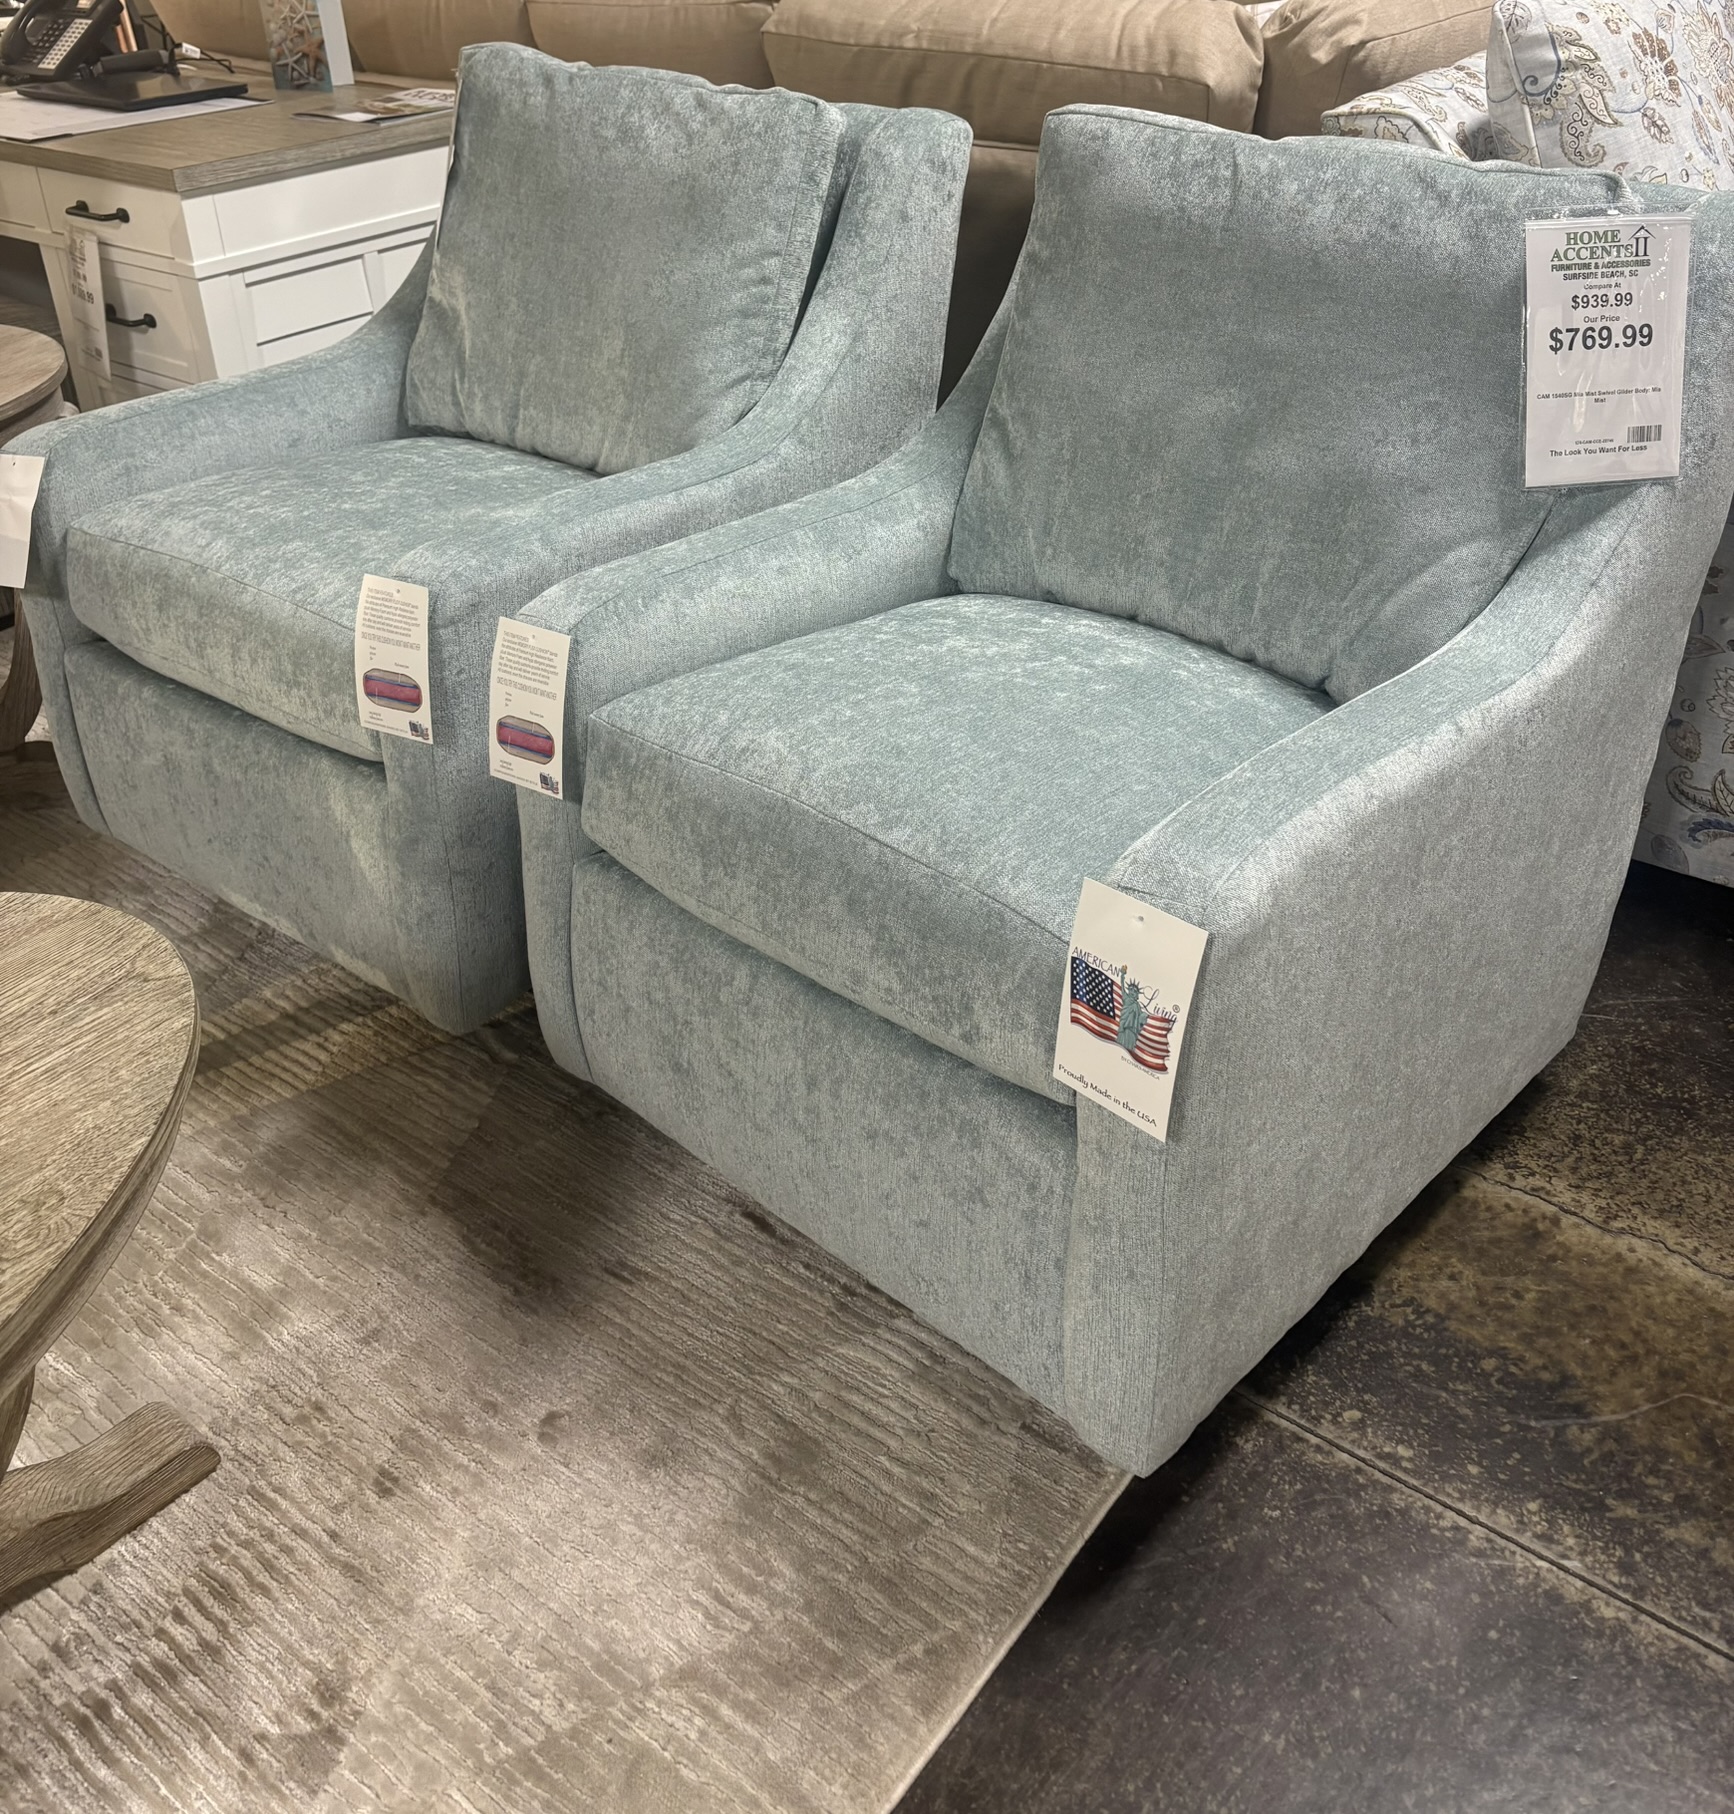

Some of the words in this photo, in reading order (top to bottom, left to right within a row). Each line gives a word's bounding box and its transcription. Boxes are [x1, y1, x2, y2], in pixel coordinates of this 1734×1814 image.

[1565, 229, 1621, 246] HOME
[1550, 244, 1634, 262] ACCENTS
[1551, 262, 1593, 272] FURNITURE
[1594, 261, 1600, 270] &
[1601, 259, 1651, 269] ACCESSORIES
[1563, 272, 1599, 281] SURFSIDE
[1601, 270, 1627, 279] BEACH,
[1629, 269, 1639, 277] SC
[1583, 283, 1613, 291] Compare
[1571, 292, 1633, 310] $939.99
[1583, 315, 1599, 323] Our
[1600, 314, 1621, 323] Price
[1549, 323, 1653, 355] $769.99
[1550, 449, 1563, 457] The
[1564, 448, 1582, 456] Look
[1583, 447, 1597, 455] You
[1618, 445, 1630, 453] For
[1631, 444, 1648, 452] Less
[1072, 946, 1121, 978] AMERICAN
[1058, 1063, 1089, 1089] Proudly
[1089, 1082, 1112, 1101] Made
[1113, 1096, 1121, 1106] in
[1122, 1101, 1136, 1115] the
[1136, 1110, 1157, 1127] USA
